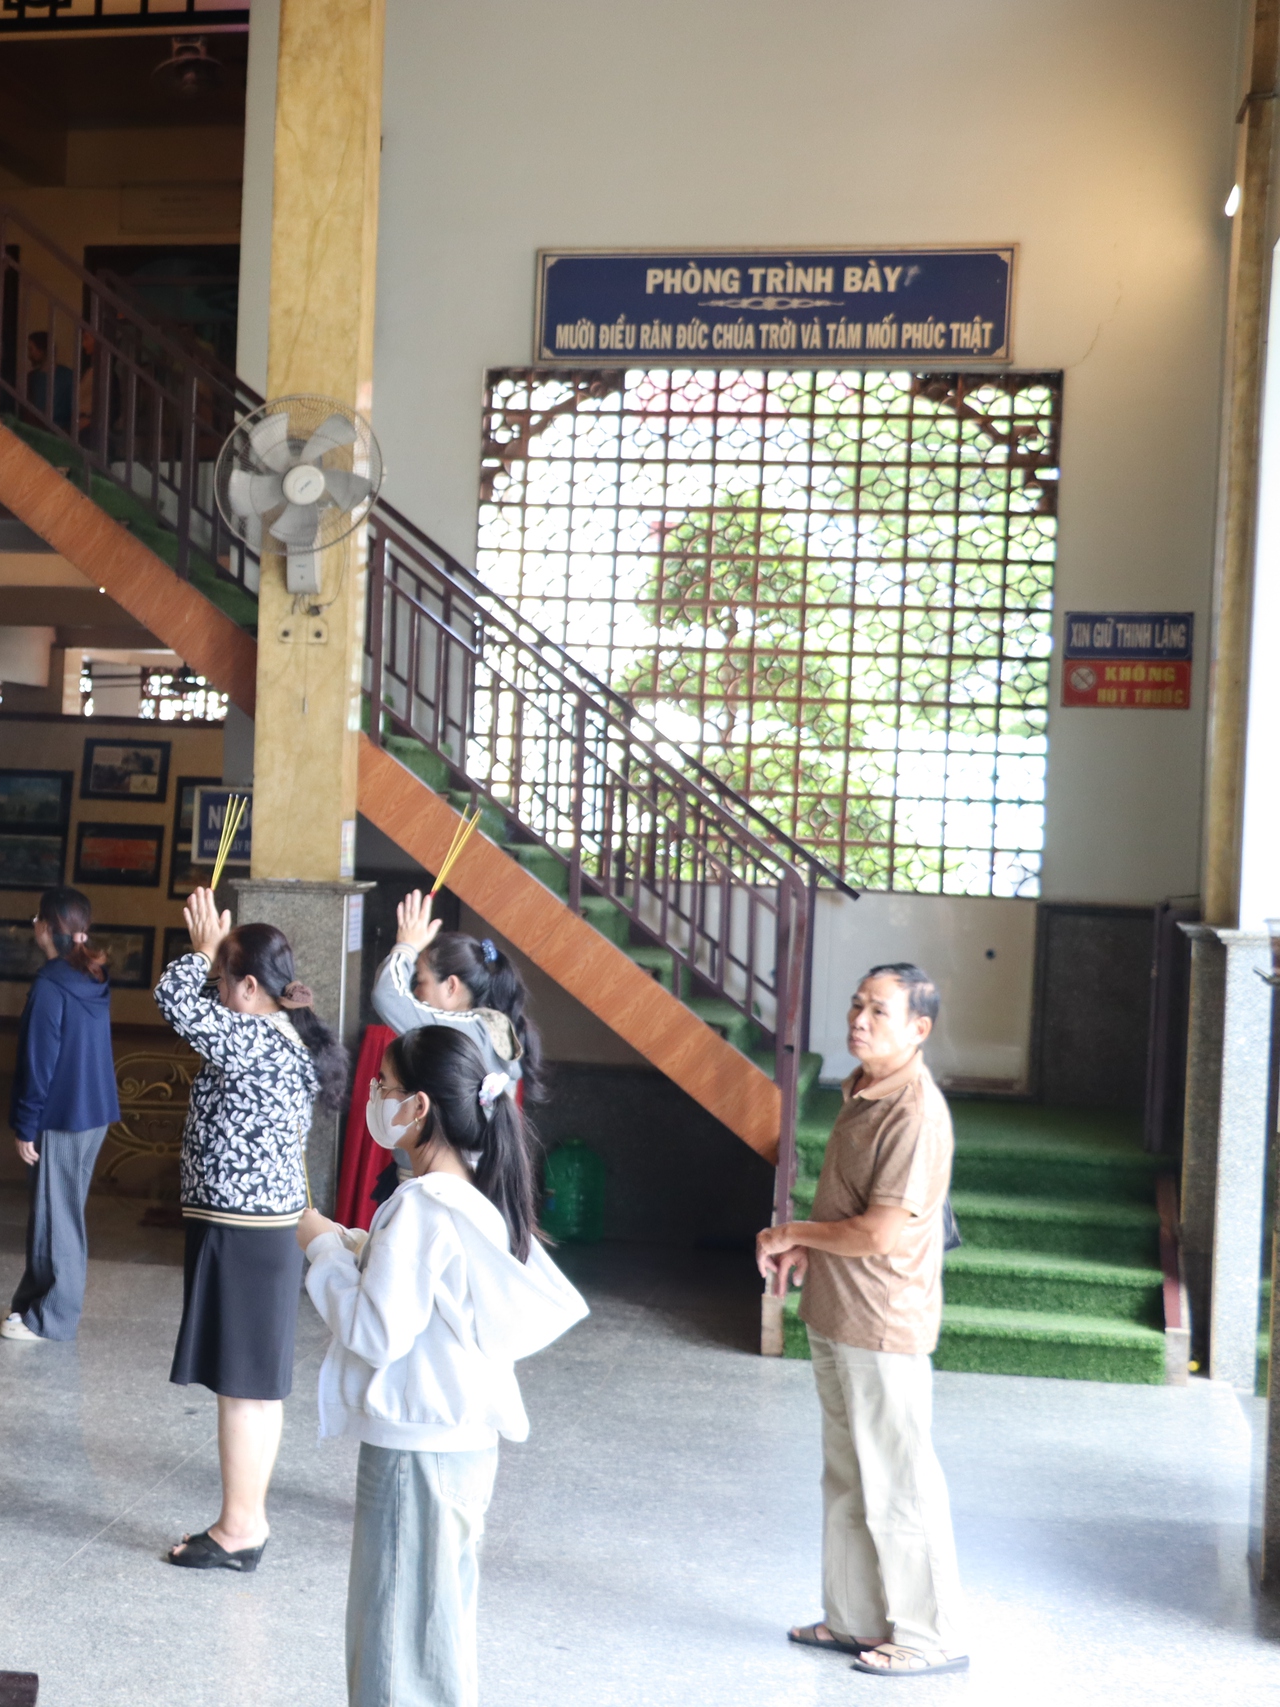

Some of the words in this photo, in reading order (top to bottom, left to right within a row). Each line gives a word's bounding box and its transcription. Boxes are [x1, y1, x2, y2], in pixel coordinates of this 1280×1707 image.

[645, 261, 741, 294] PHÒNG
[748, 260, 834, 293] TRÌNH
[843, 259, 902, 293] BÀY
[556, 317, 595, 349] MƯỜI
[599, 313, 636, 349] ĐIỀU
[640, 319, 671, 349] RĂN
[676, 317, 708, 349] ĐỨC
[712, 317, 755, 349] CHÚA
[759, 317, 796, 349] TRỜI
[801, 317, 820, 349] VÀ
[826, 317, 862, 349] TÁM
[866, 313, 898, 349] MỐI
[901, 316, 946, 349] PHÚC
[950, 316, 994, 354] THẬT
[1070, 623, 1091, 648] XIN
[1105, 664, 1176, 682] KHÔNG
[1097, 686, 1127, 703] HÚT
[1135, 686, 1183, 704] THUỐC
